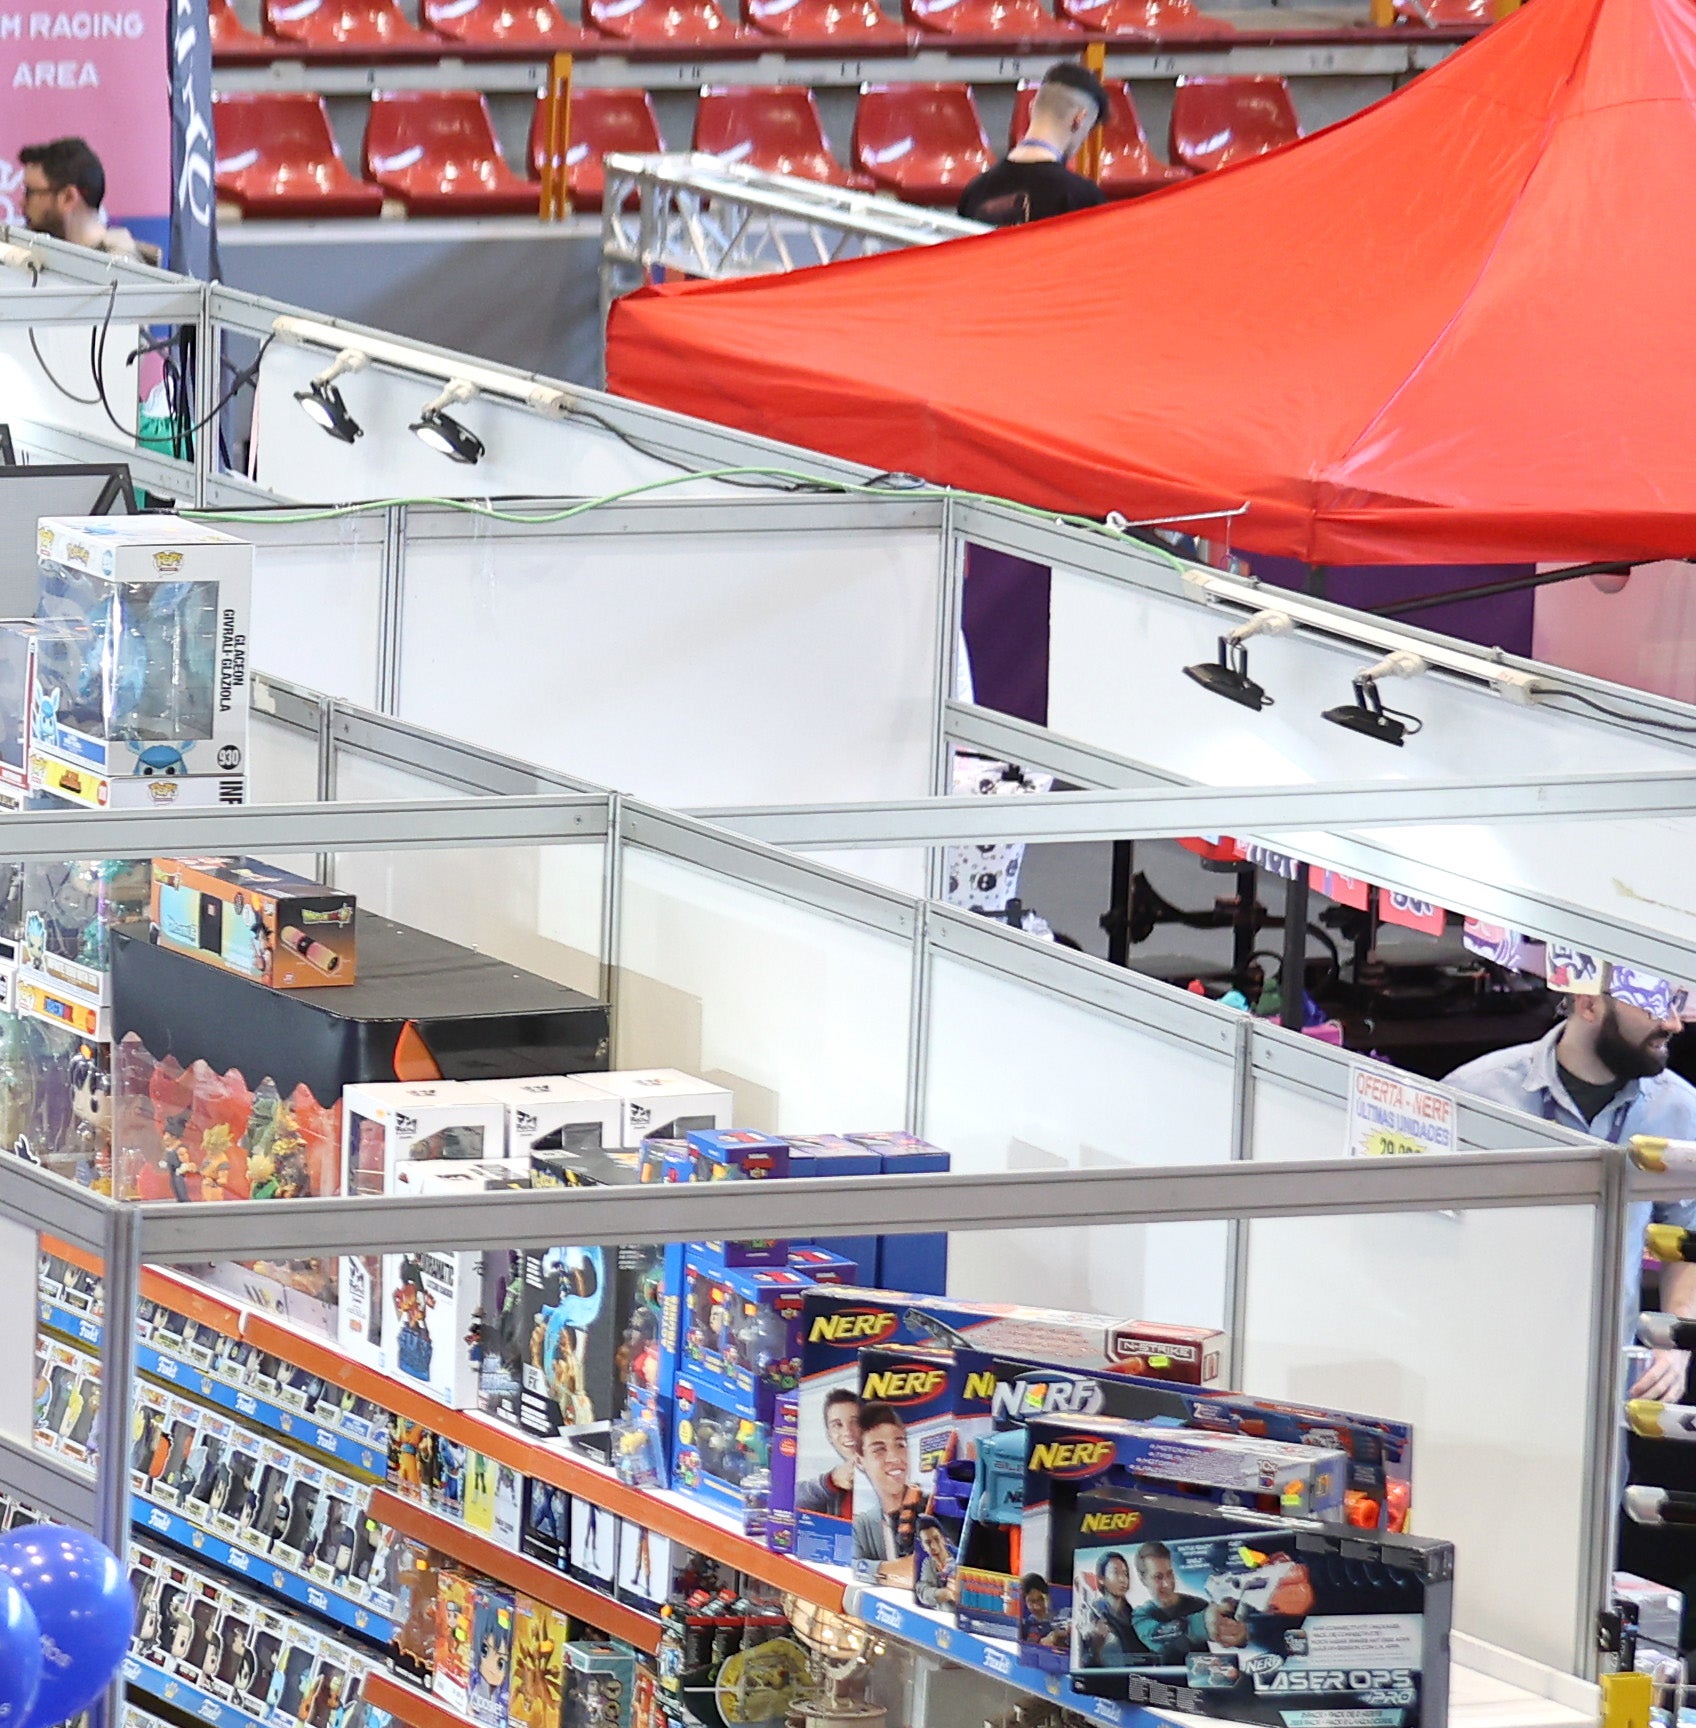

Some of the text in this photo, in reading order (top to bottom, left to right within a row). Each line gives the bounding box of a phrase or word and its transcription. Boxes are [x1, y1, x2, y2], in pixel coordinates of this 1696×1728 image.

[30, 11, 144, 40] RACING
[12, 60, 100, 89] AREA
[217, 748, 241, 768] 930
[1356, 1072, 1450, 1123] OFERTA NERF
[1396, 1114, 1450, 1147] UNIDADES
[808, 1310, 896, 1345] NERF
[1121, 1340, 1193, 1359] N-STRIKE
[861, 1368, 945, 1402] NERF
[1028, 1439, 1113, 1472] NERF
[1080, 1509, 1140, 1534] NERF
[1244, 1655, 1283, 1674] NERF
[1253, 1668, 1413, 1692] LASER OPS
